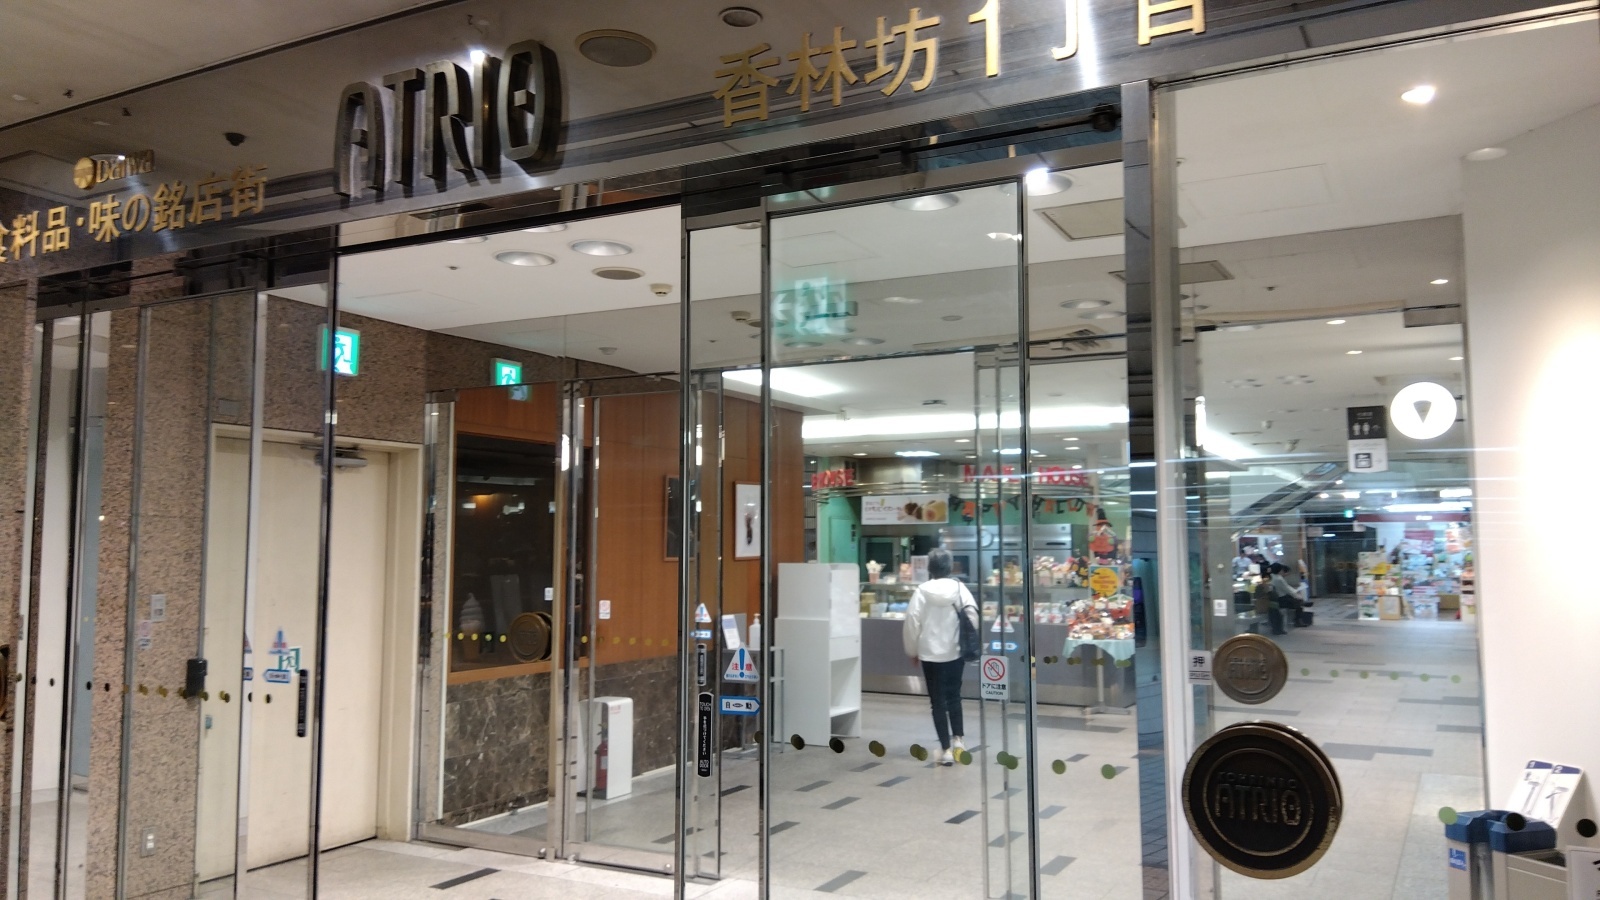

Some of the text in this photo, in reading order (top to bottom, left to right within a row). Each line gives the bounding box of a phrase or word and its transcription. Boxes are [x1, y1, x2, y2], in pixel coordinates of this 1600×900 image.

[334, 39, 563, 198] ATRIO
[982, 682, 1007, 691] ドアに注意
[1214, 783, 1301, 826] ATRIO
